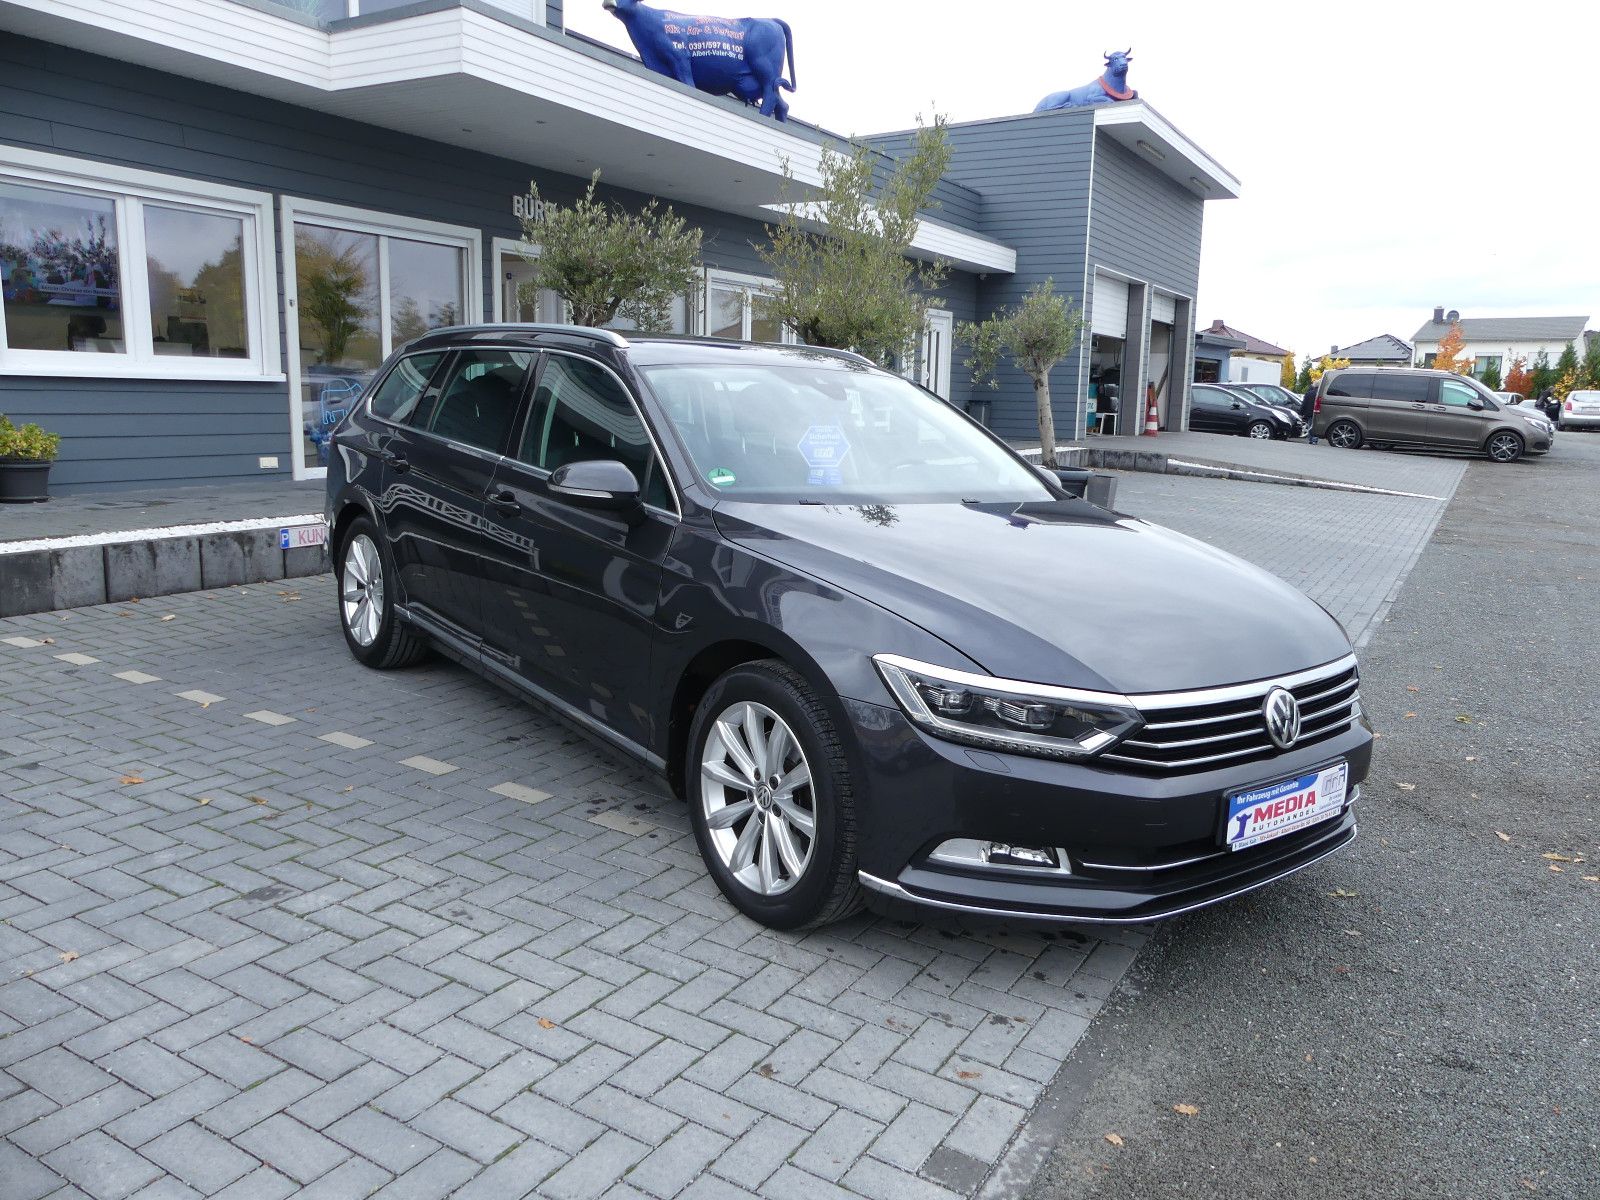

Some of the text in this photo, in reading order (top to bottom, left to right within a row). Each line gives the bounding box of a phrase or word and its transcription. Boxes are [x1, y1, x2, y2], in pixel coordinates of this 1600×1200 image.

[672, 41, 687, 50] Tel.
[688, 41, 721, 51] 0391/597
[1237, 795, 1246, 804] Ihr
[1246, 790, 1270, 802] Fahrzeug
[1280, 781, 1299, 793] Garantie
[1252, 790, 1316, 824] MEDIA
[1251, 807, 1315, 833] AUTOHANDEL
